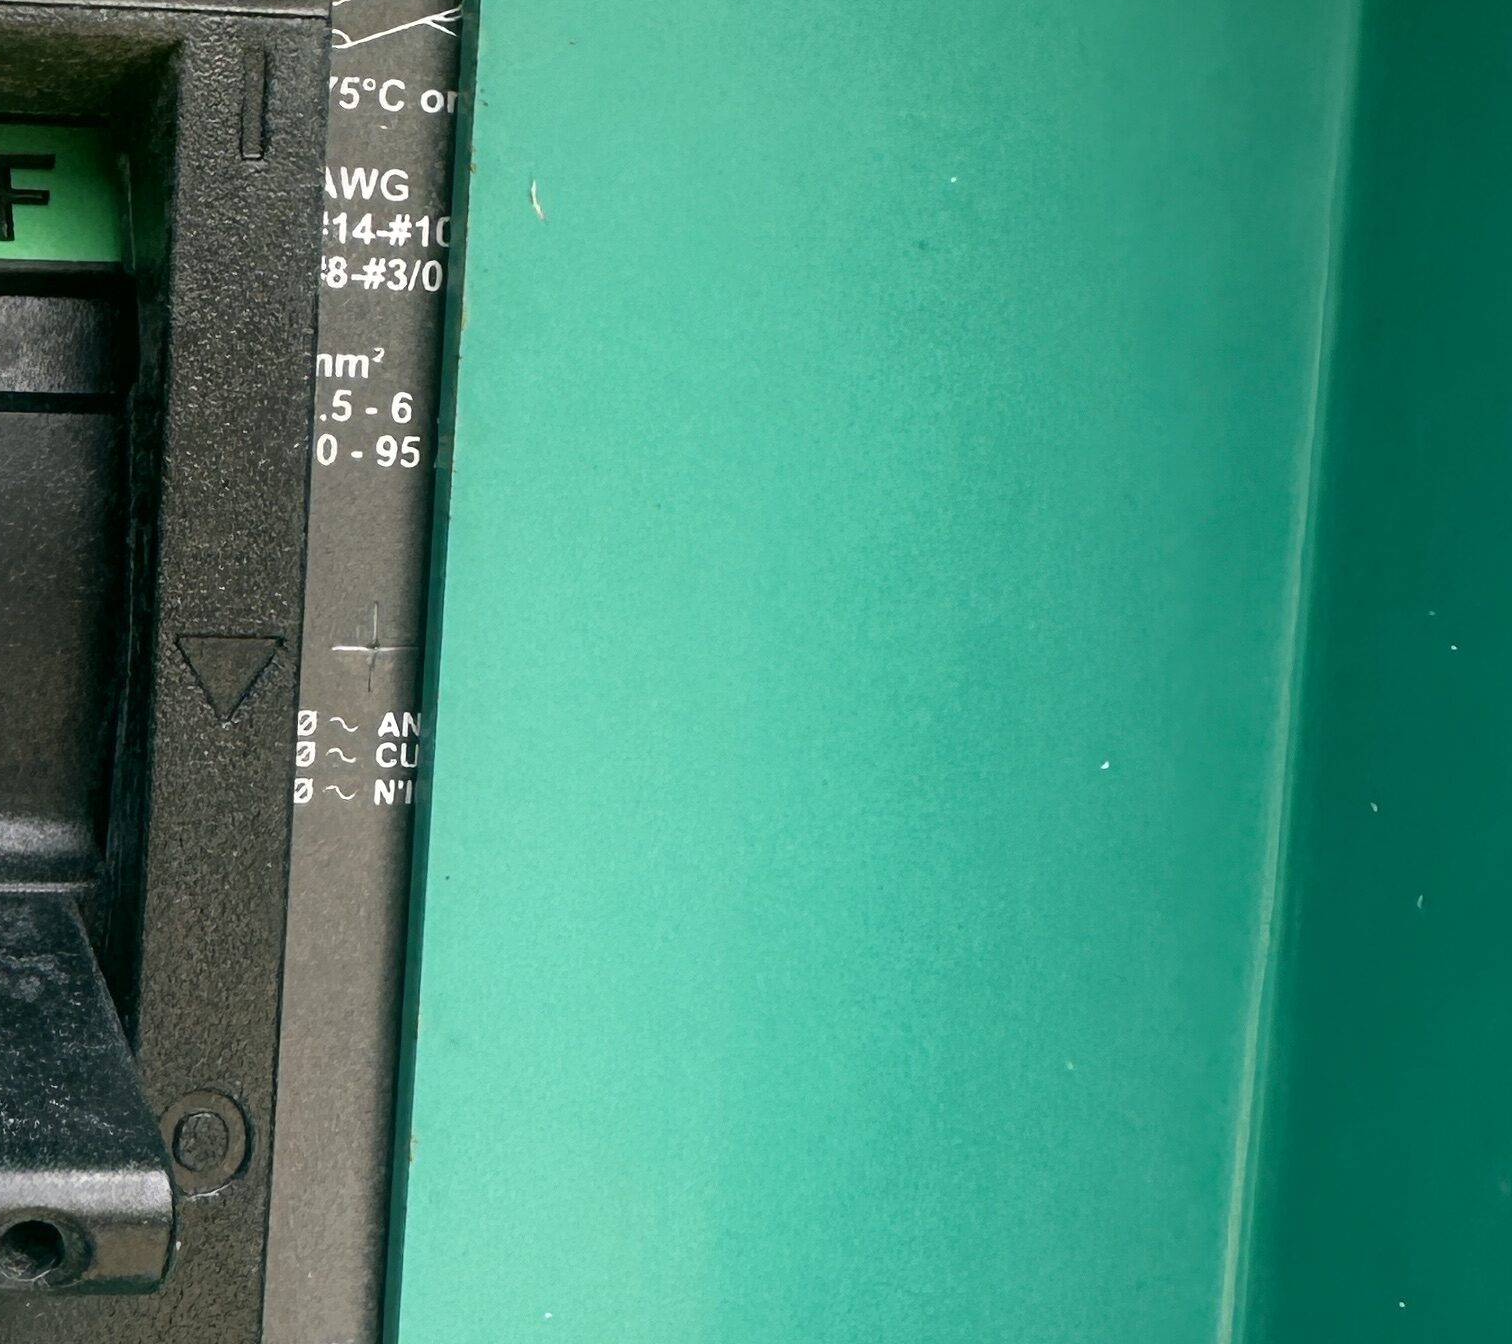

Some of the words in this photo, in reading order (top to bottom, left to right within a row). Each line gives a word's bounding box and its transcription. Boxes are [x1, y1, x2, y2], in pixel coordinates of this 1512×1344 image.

[322, 211, 450, 248] 14-#10
[320, 255, 443, 293] 8-#3/0
[391, 391, 413, 424] 6
[375, 434, 421, 468] 95
[377, 711, 421, 738] AN
[375, 741, 419, 768] CU
